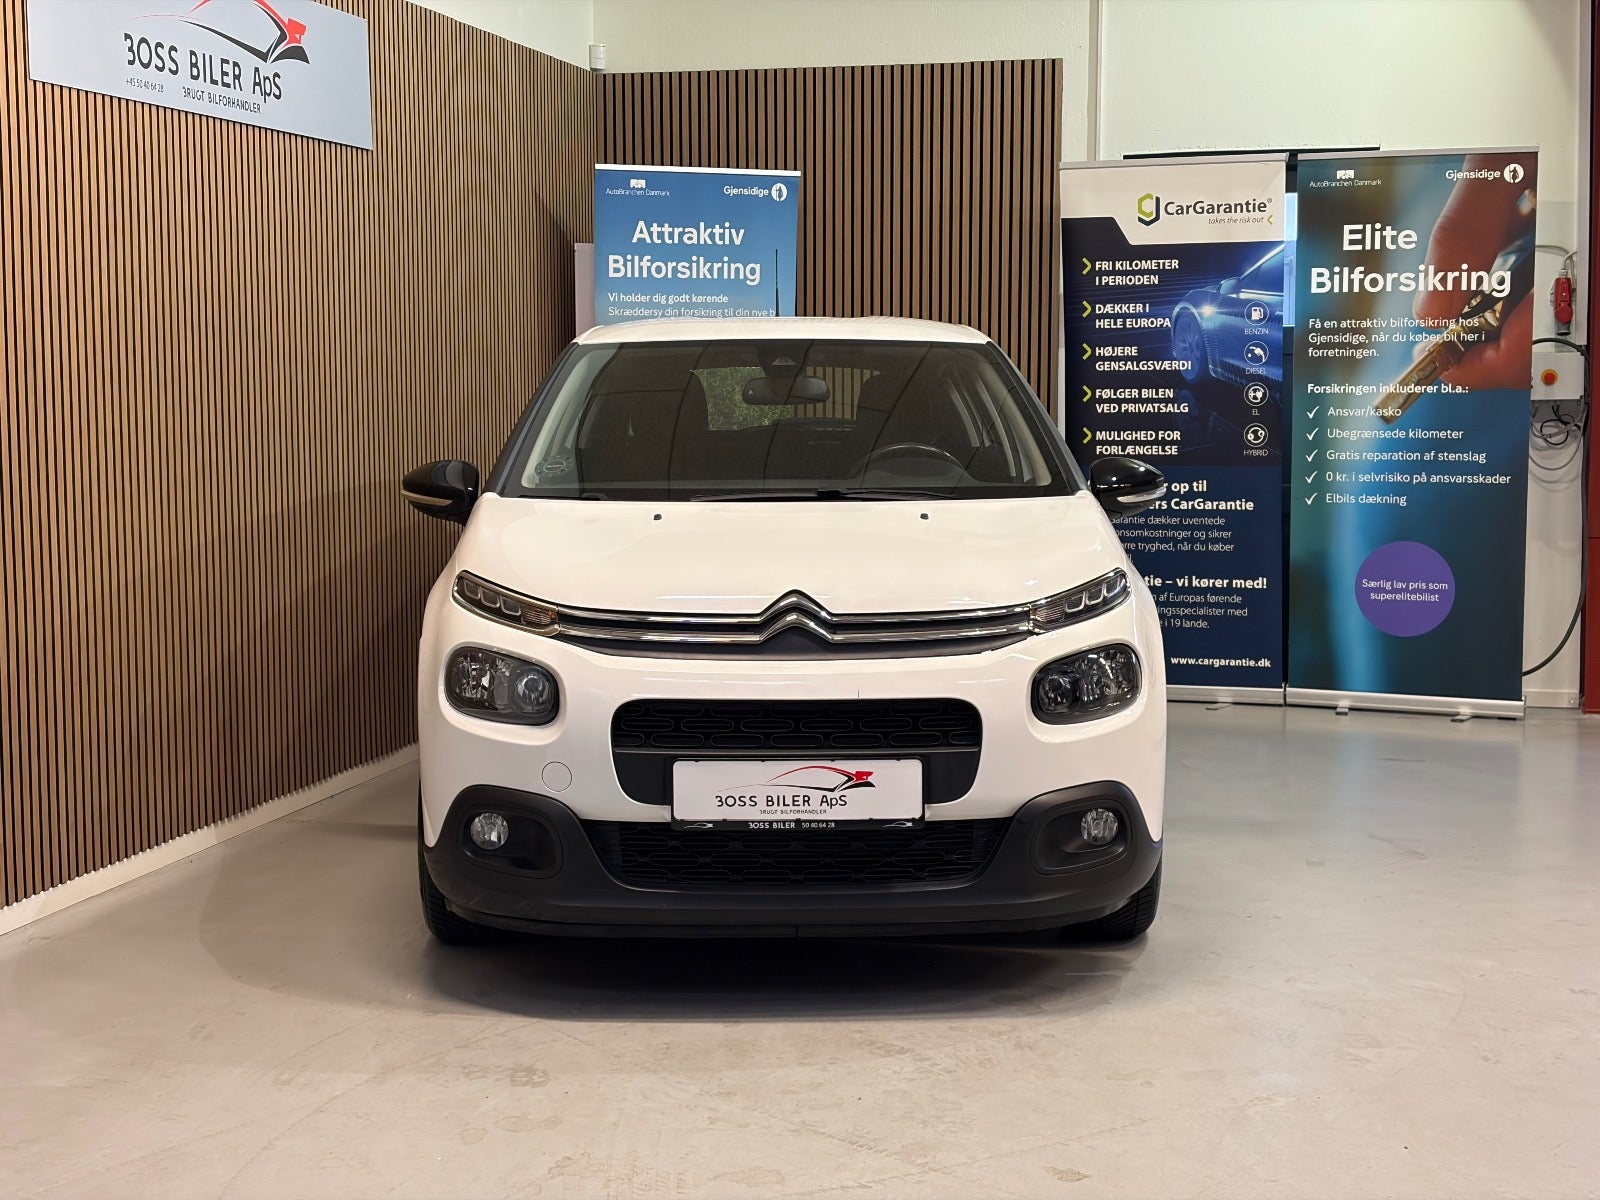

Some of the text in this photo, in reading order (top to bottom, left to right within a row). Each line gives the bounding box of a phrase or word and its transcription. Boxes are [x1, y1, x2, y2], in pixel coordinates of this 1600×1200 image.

[190, 50, 242, 91] BILER
[252, 66, 282, 103] ApS
[137, 79, 142, 88] 50
[144, 81, 150, 89] 40
[151, 82, 157, 90] 64
[158, 84, 163, 92] 28
[207, 93, 261, 113] BILFORHANDLER
[1445, 169, 1501, 181] Gjensidige
[723, 185, 769, 197] Gjensidige
[1209, 216, 1226, 224] takes
[1227, 216, 1238, 224] the
[1239, 216, 1251, 224] risk
[632, 220, 745, 245] Attraktiv
[1343, 223, 1418, 251] Elite
[608, 254, 761, 285] Bilforsikring
[1095, 259, 1179, 271] FRI KILOMETER
[1095, 274, 1159, 285] I PERIODEN
[1310, 264, 1512, 298] Bilforsikring
[608, 293, 729, 304] Vi holder dig godt kørende
[608, 307, 662, 318] Skræddersy
[665, 308, 678, 316] din
[681, 308, 722, 318] forsikring
[725, 308, 733, 316] til
[736, 308, 749, 316] din
[1095, 304, 1143, 314] DÆKKER
[1096, 318, 1171, 328] HELE EUROPA
[1308, 319, 1322, 329] Få
[1340, 319, 1388, 328] attraktiv
[1390, 318, 1456, 328] bilforsikring
[1458, 318, 1479, 327] hos
[1245, 327, 1269, 335] BENZIN
[1308, 333, 1369, 344] Gjensidige,
[1371, 332, 1390, 342] når
[1392, 333, 1407, 342] du
[1409, 332, 1441, 342] køber
[1444, 332, 1457, 341] bil
[1460, 332, 1479, 341] her
[1095, 347, 1138, 357] HØJERE
[1308, 347, 1379, 358] forretningen.
[1096, 360, 1191, 371] GENSALGSVÆRDI
[1095, 388, 1174, 399] FØLGER BILEN
[1307, 384, 1469, 395] Forsikringen inkluderer bl.a.:
[1096, 403, 1189, 413] VED PRIVATSALG
[1327, 406, 1402, 417] Ansvar/kasko
[1096, 431, 1181, 440] MULIGHED FOR
[1327, 429, 1464, 441] Ubegrænsede kilometer
[1096, 445, 1178, 455] FORLÆNGELSE
[1326, 450, 1486, 463] Gratis reparation af stenslag
[1326, 472, 1333, 482] 0
[1336, 472, 1349, 482] kr.
[1358, 472, 1410, 483] selvrisiko
[1413, 472, 1427, 485] på
[1430, 473, 1511, 484] ansvarsskader
[1171, 482, 1189, 495] op
[1192, 480, 1207, 492] til
[1171, 499, 1254, 511] CarGarantie
[1326, 493, 1407, 507] Elbils dækning
[1111, 516, 1225, 525] arantie dækker uventede
[1116, 529, 1232, 539] onsomkostninger og sikrer
[1138, 542, 1175, 552] tryghed,
[1177, 543, 1191, 551] når
[1193, 543, 1206, 551] du
[1208, 543, 1235, 551] køber
[1176, 576, 1189, 587] vi
[1192, 576, 1229, 588] kører
[1232, 577, 1267, 588] med!
[1362, 579, 1448, 590] Særlig lav pris som
[1159, 593, 1168, 601] af
[1169, 594, 1205, 604] Europas
[1207, 594, 1242, 603] førende
[1370, 592, 1440, 602] superelitebilist
[1157, 607, 1248, 617] ingsspecialister med
[1170, 620, 1181, 628] 19
[1183, 620, 1210, 628] lande.
[1171, 657, 1271, 667] www.cargarantie.dk
[765, 794, 811, 807] BILER
[819, 794, 848, 810] ApS
